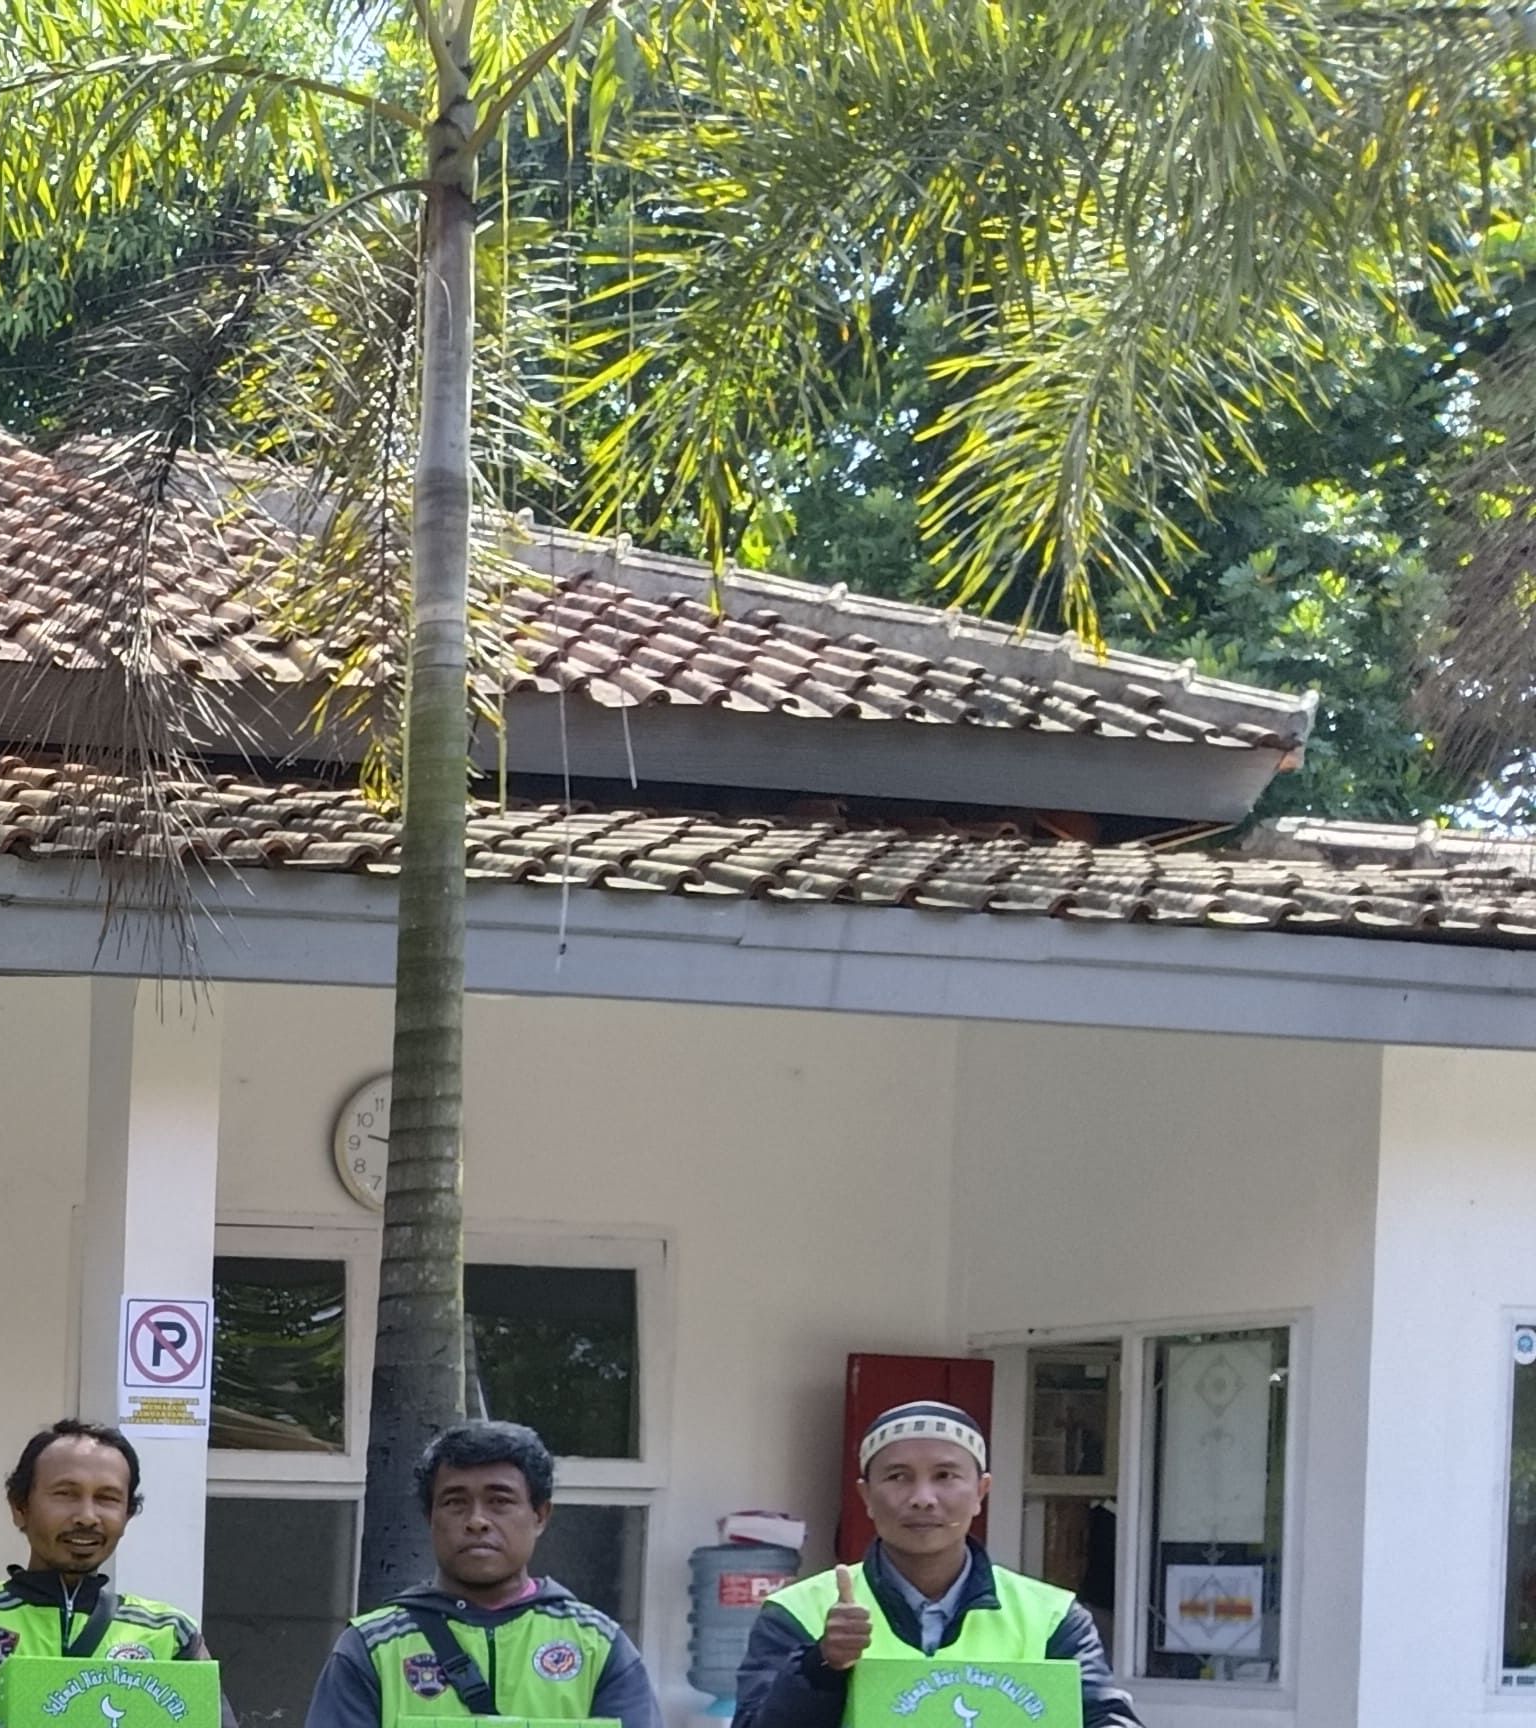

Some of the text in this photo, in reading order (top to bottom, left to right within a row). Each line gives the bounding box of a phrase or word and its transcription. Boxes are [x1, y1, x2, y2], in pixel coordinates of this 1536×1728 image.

[375, 1098, 385, 1112] 11
[357, 1112, 374, 1128] 10
[349, 1135, 360, 1151] 9
[354, 1158, 366, 1174] 8
[372, 1175, 382, 1191] 7
